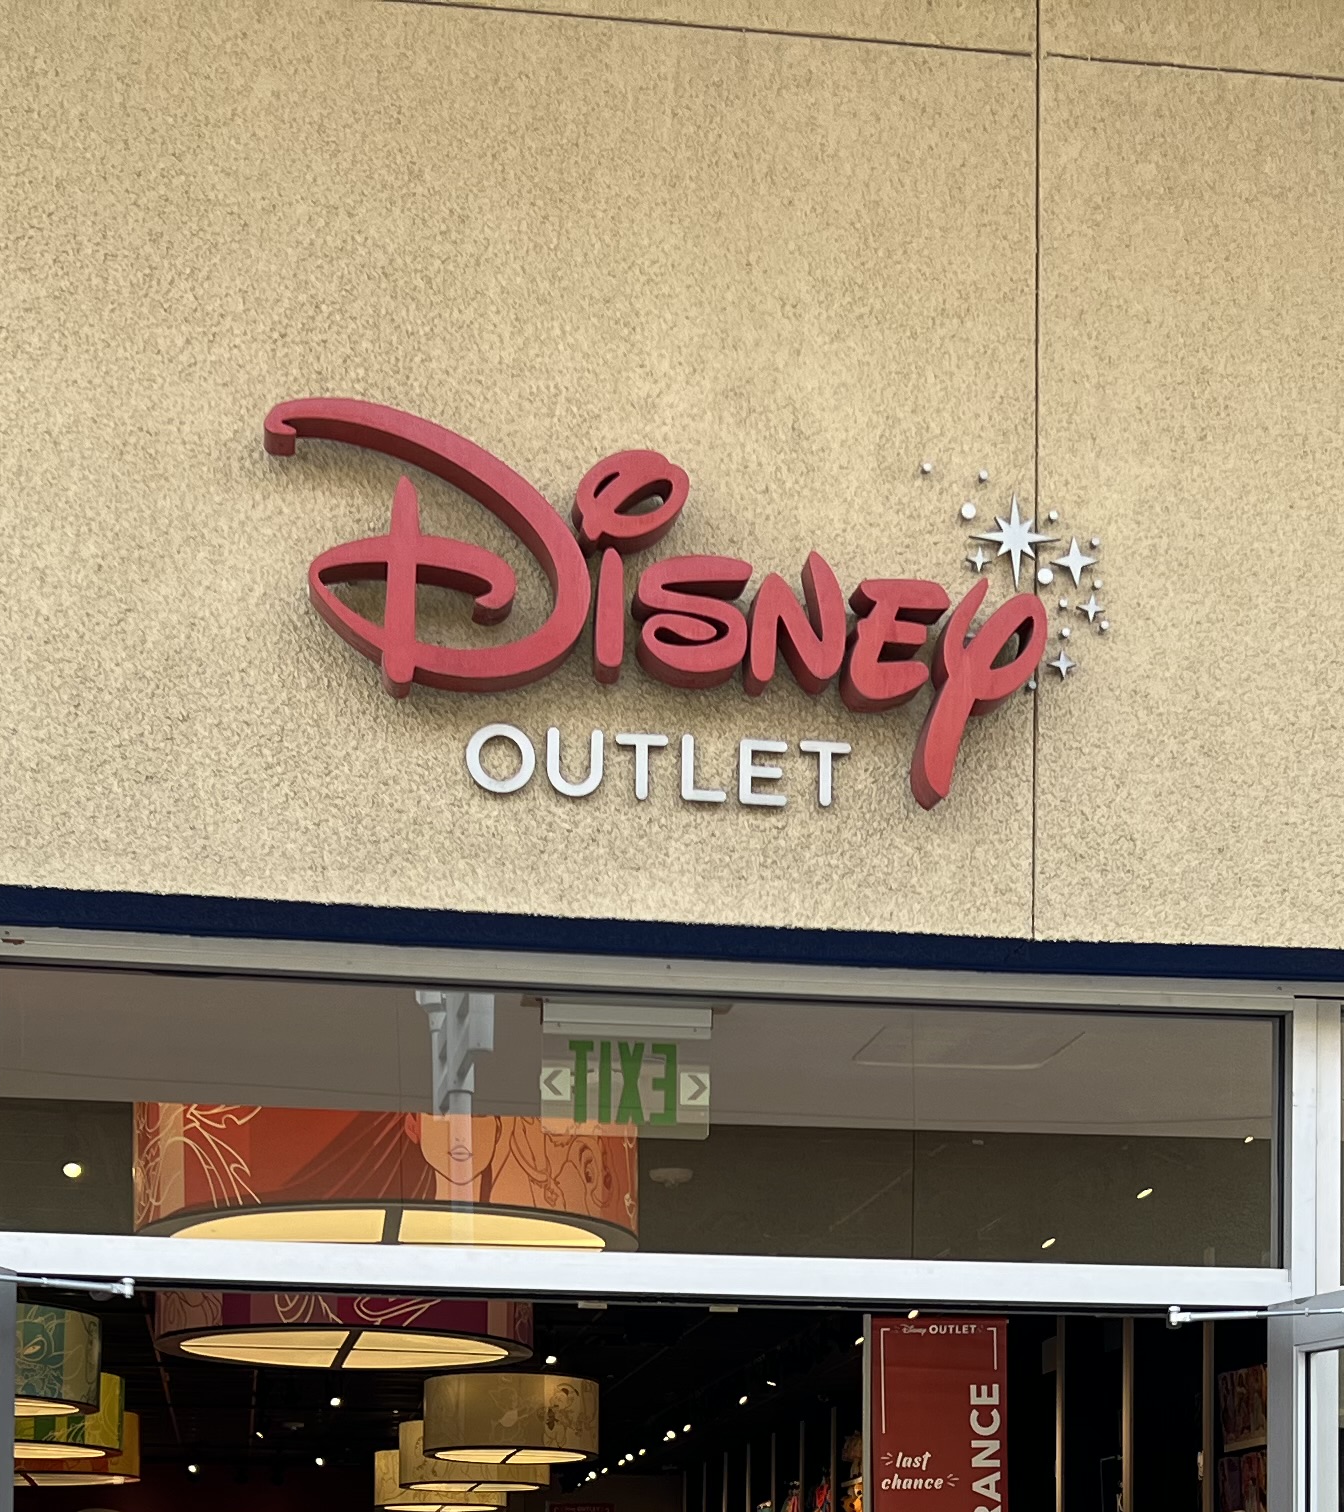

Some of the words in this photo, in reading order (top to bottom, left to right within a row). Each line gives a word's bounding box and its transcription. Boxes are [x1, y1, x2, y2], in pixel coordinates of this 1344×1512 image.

[264, 397, 1049, 812] Disney
[465, 722, 853, 807] OUTLET
[899, 1323, 927, 1337] Disney
[928, 1324, 977, 1335] OUTLET
[895, 1450, 931, 1471] last
[881, 1473, 945, 1492] chance
